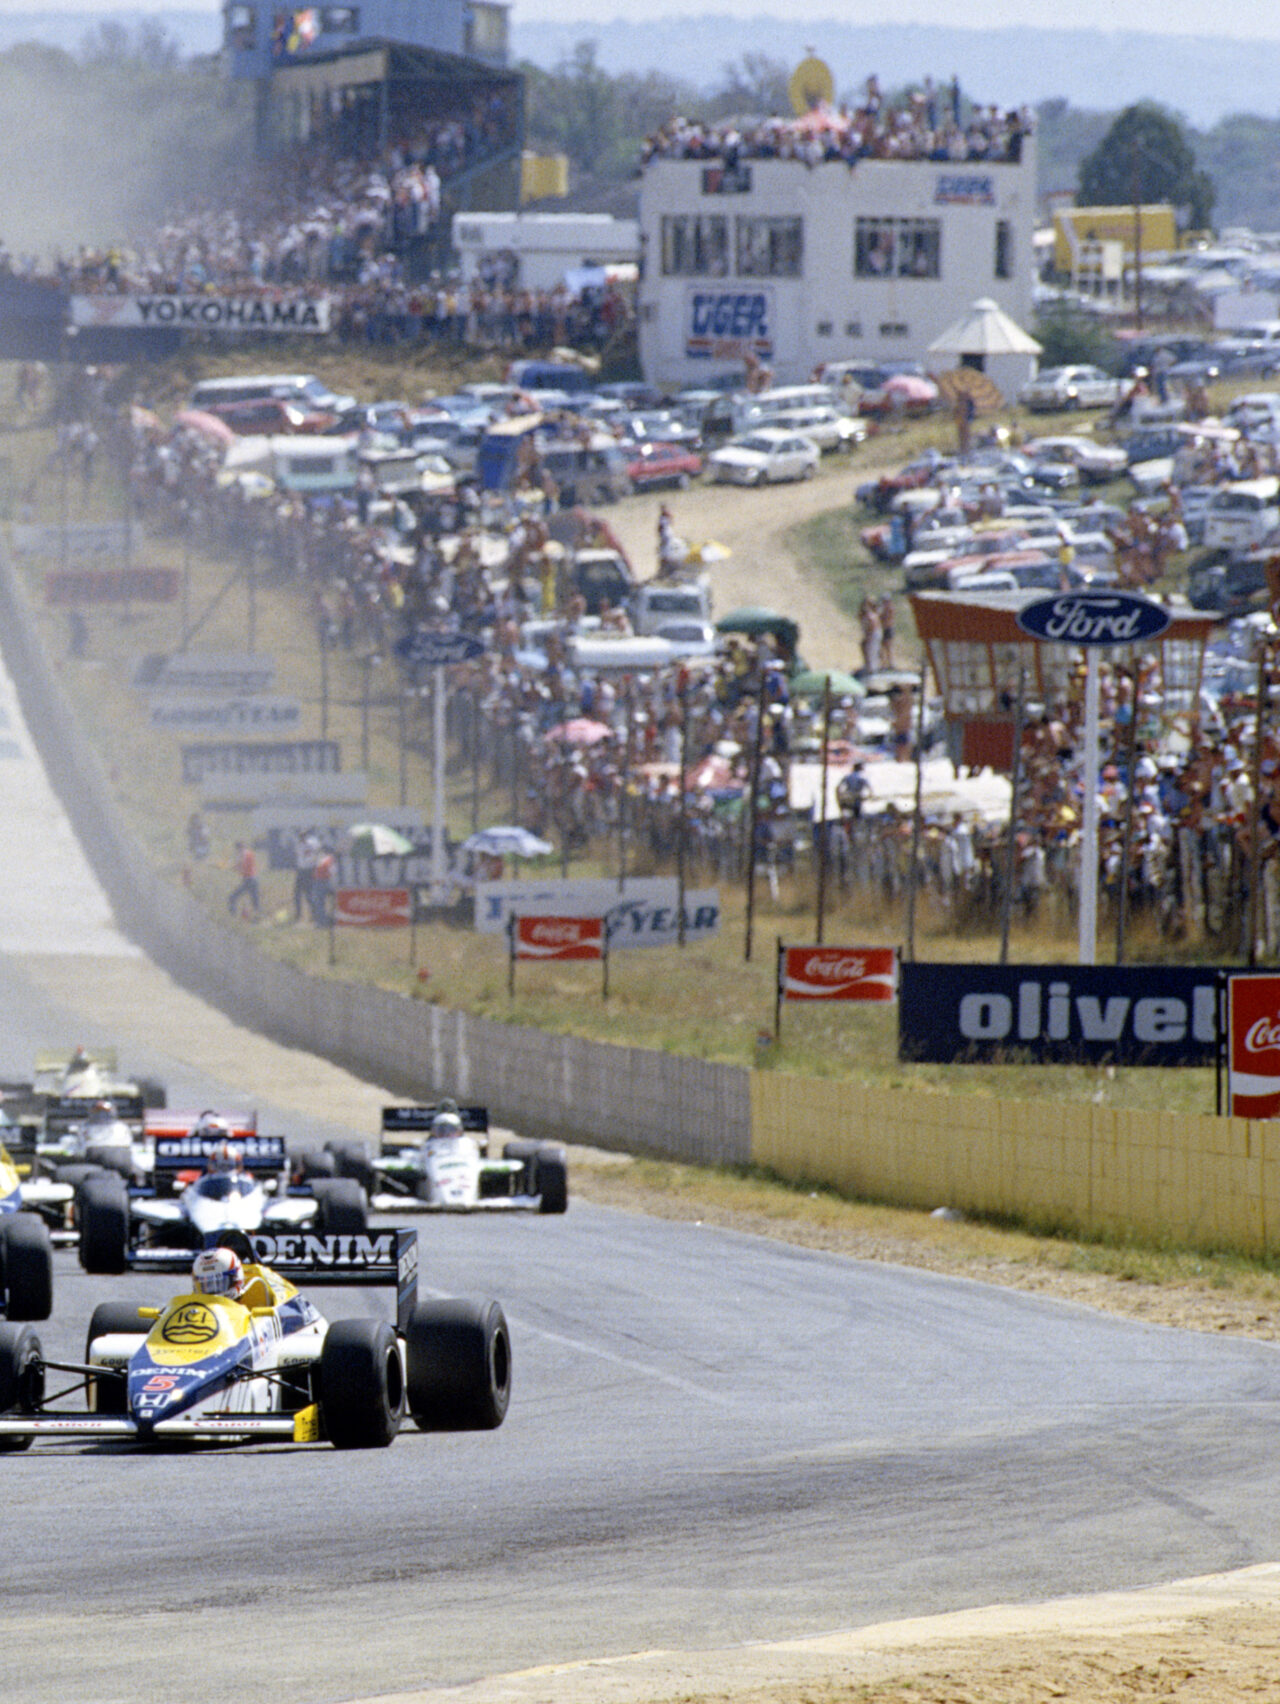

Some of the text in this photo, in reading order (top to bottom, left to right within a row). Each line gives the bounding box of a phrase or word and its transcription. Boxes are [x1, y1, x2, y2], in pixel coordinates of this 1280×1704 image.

[136, 299, 318, 325] YOKOHAMA
[1045, 599, 1142, 639] Ford
[245, 1234, 395, 1265] DENIM
[177, 1310, 207, 1324] ICI
[131, 1367, 208, 1379] DENIM
[142, 1375, 181, 1391] 5
